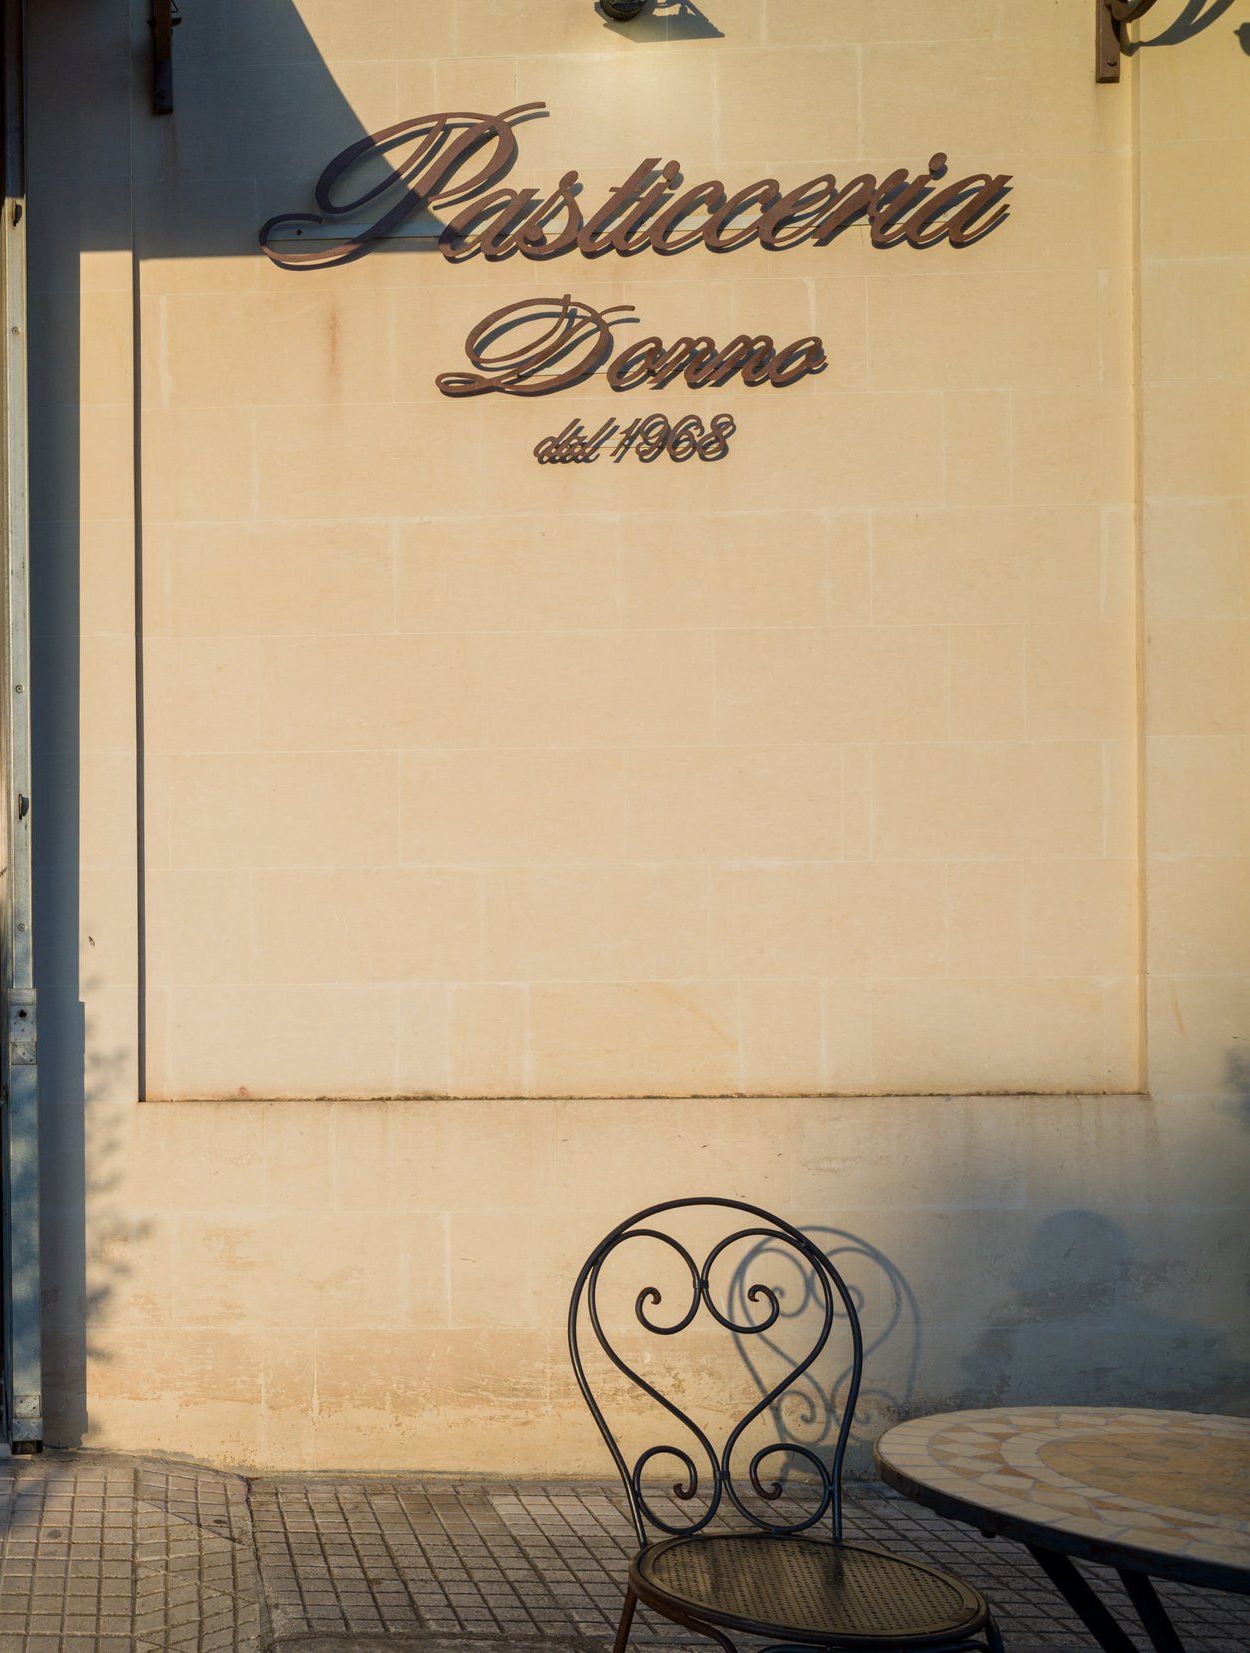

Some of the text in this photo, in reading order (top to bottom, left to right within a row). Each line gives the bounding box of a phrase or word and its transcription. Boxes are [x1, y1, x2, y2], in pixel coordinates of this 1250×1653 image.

[259, 102, 1013, 264] Pasticceria
[435, 294, 827, 395] Donno
[534, 413, 735, 461] dal 1968
